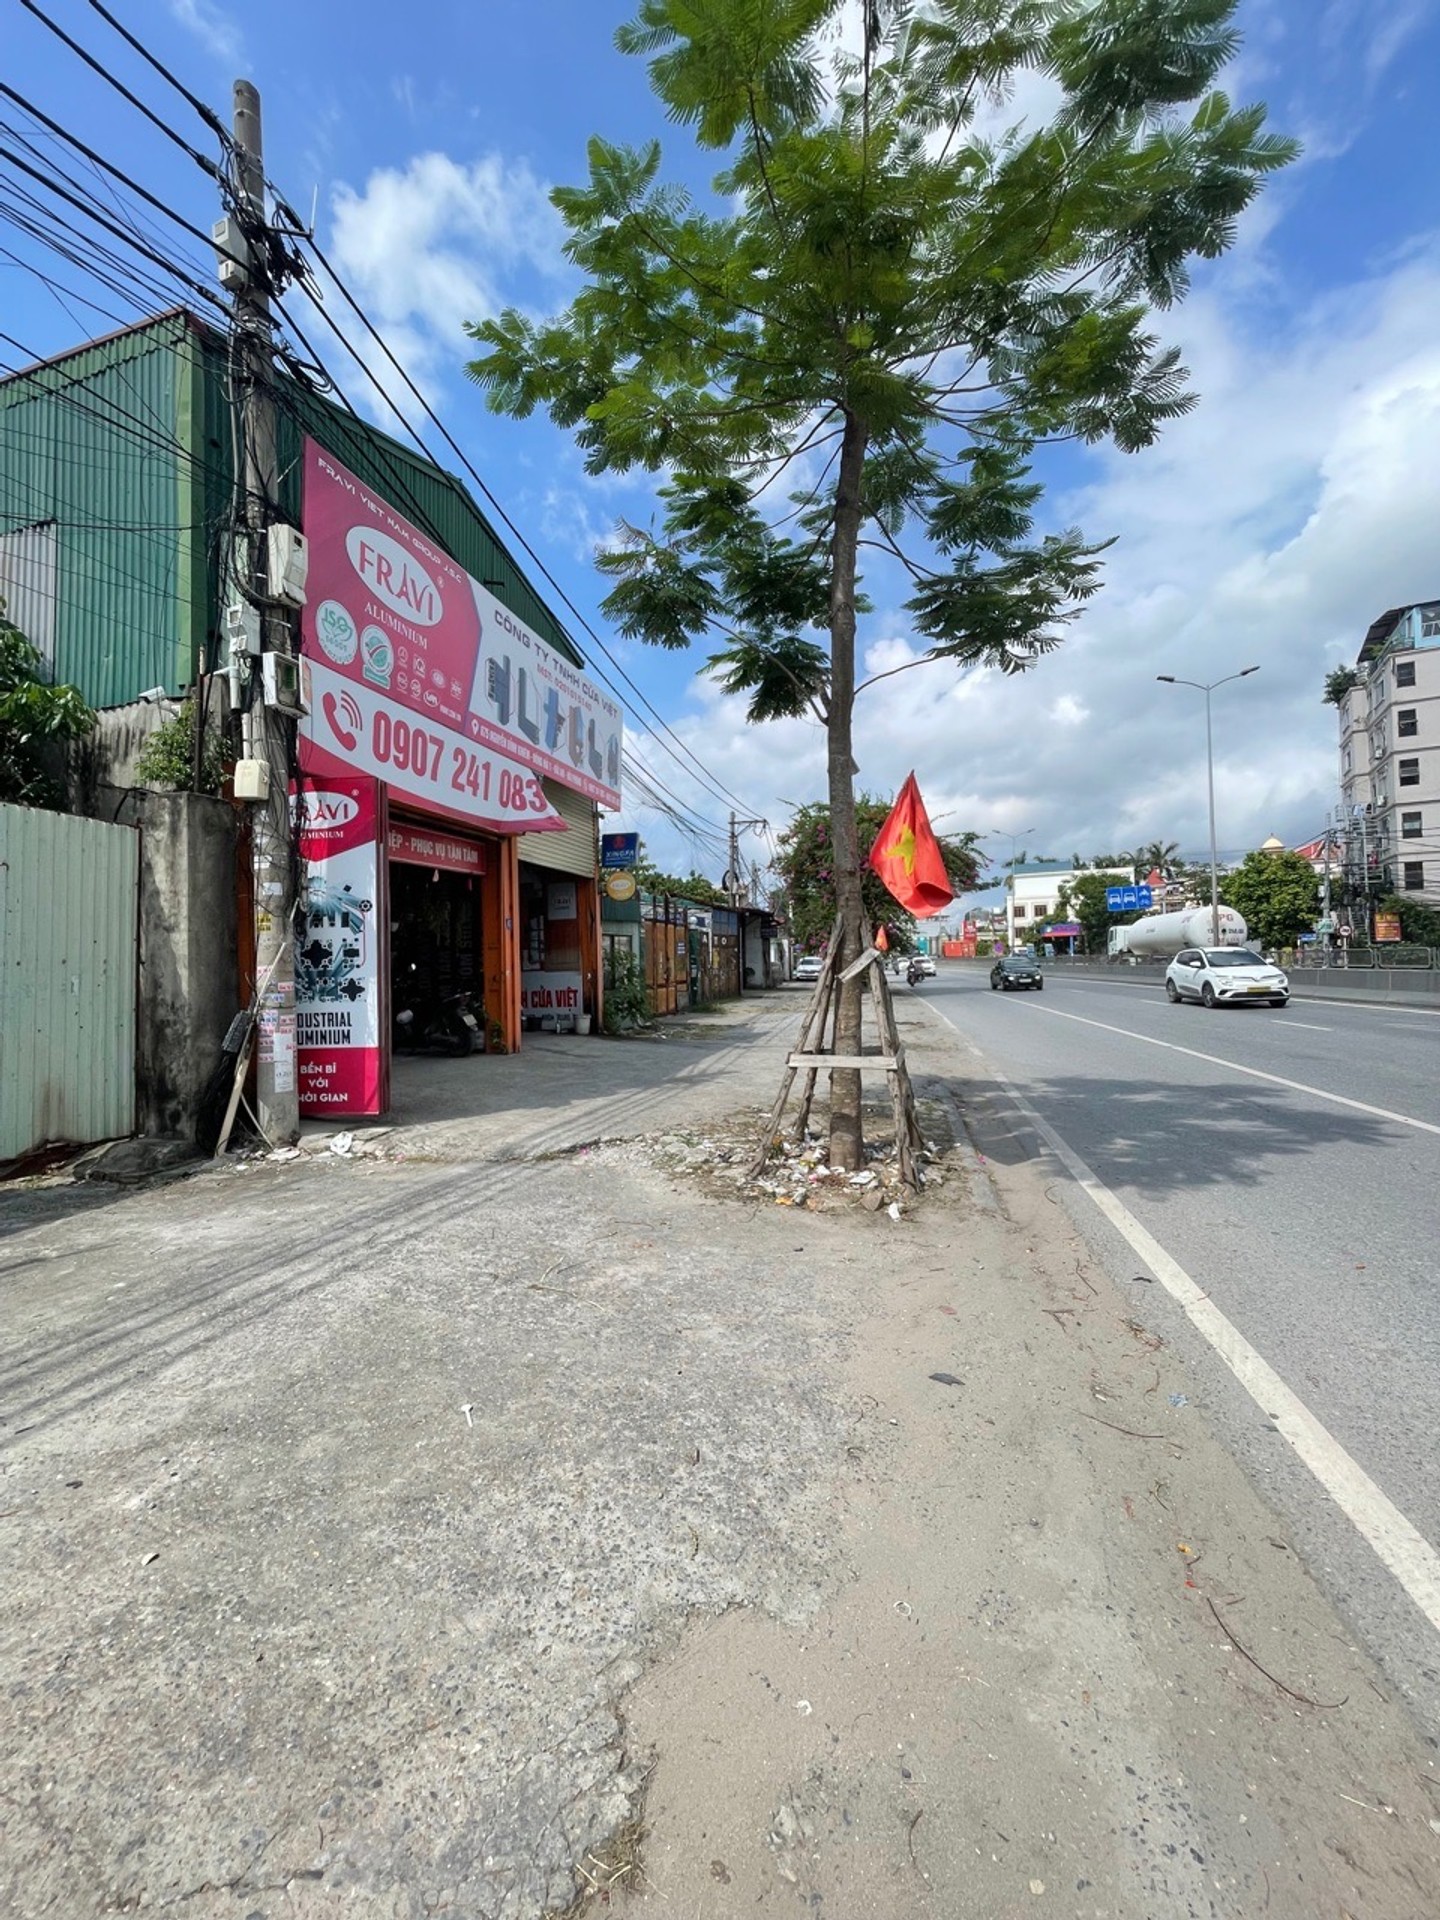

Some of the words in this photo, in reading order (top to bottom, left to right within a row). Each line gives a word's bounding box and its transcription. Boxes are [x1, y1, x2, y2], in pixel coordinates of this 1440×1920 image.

[317, 457, 355, 495] FRAVI
[360, 491, 385, 518] VIET
[387, 517, 410, 541] NAM
[412, 538, 441, 566] GROUP
[358, 540, 433, 621] FRAVI
[364, 602, 428, 650] ALUMINIUM
[494, 609, 530, 648] CÔNG
[534, 642, 549, 662] TY
[552, 658, 580, 688] TNHH
[372, 710, 444, 782] 0907
[451, 746, 491, 801] 241
[498, 769, 548, 812] 083
[289, 799, 348, 822] RAVI
[297, 1011, 352, 1028] DUSTRIAL
[297, 1029, 351, 1046] UMINIUM
[319, 1093, 348, 1102] GIAN
